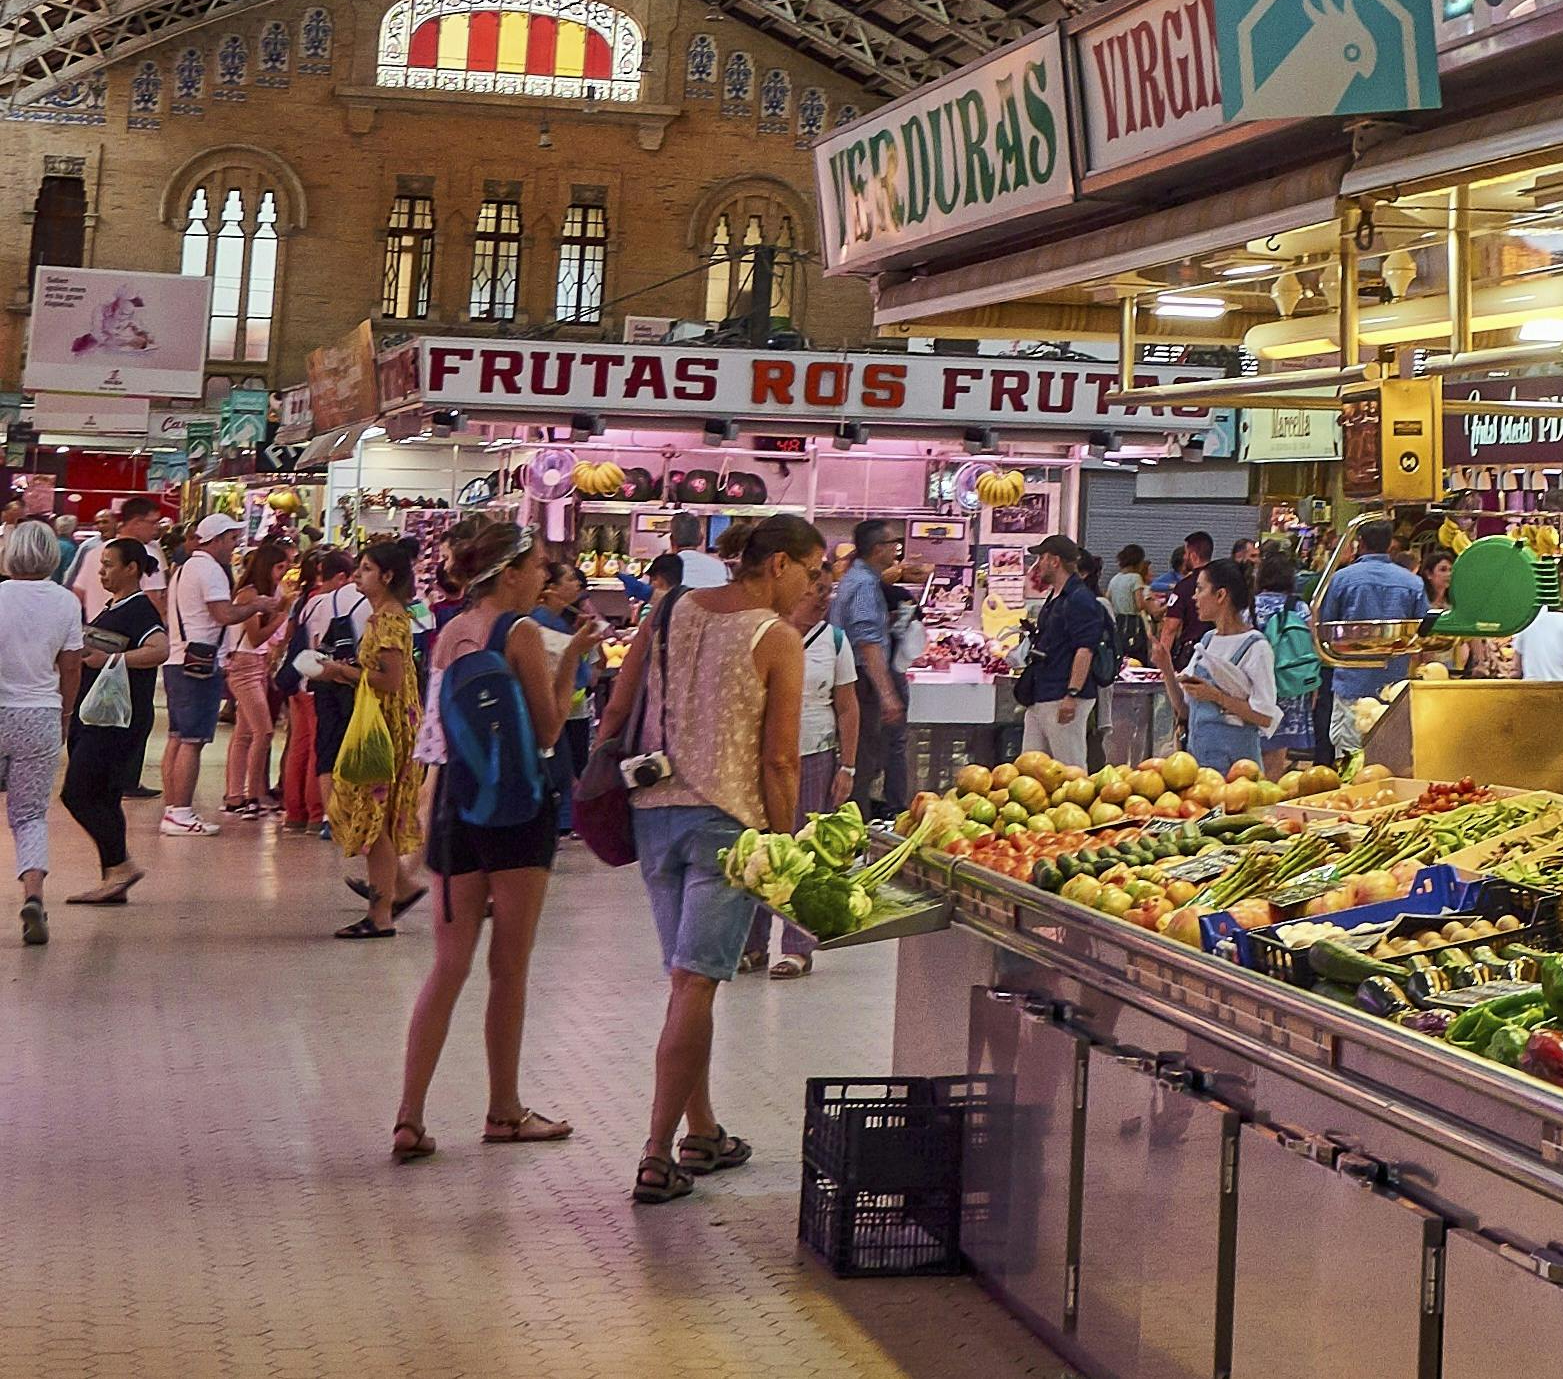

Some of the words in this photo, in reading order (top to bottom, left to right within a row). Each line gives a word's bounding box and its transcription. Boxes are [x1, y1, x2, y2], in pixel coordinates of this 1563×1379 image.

[829, 55, 1057, 250] VERDURAS
[428, 346, 720, 402] FRUTAS
[751, 358, 908, 408] ROS
